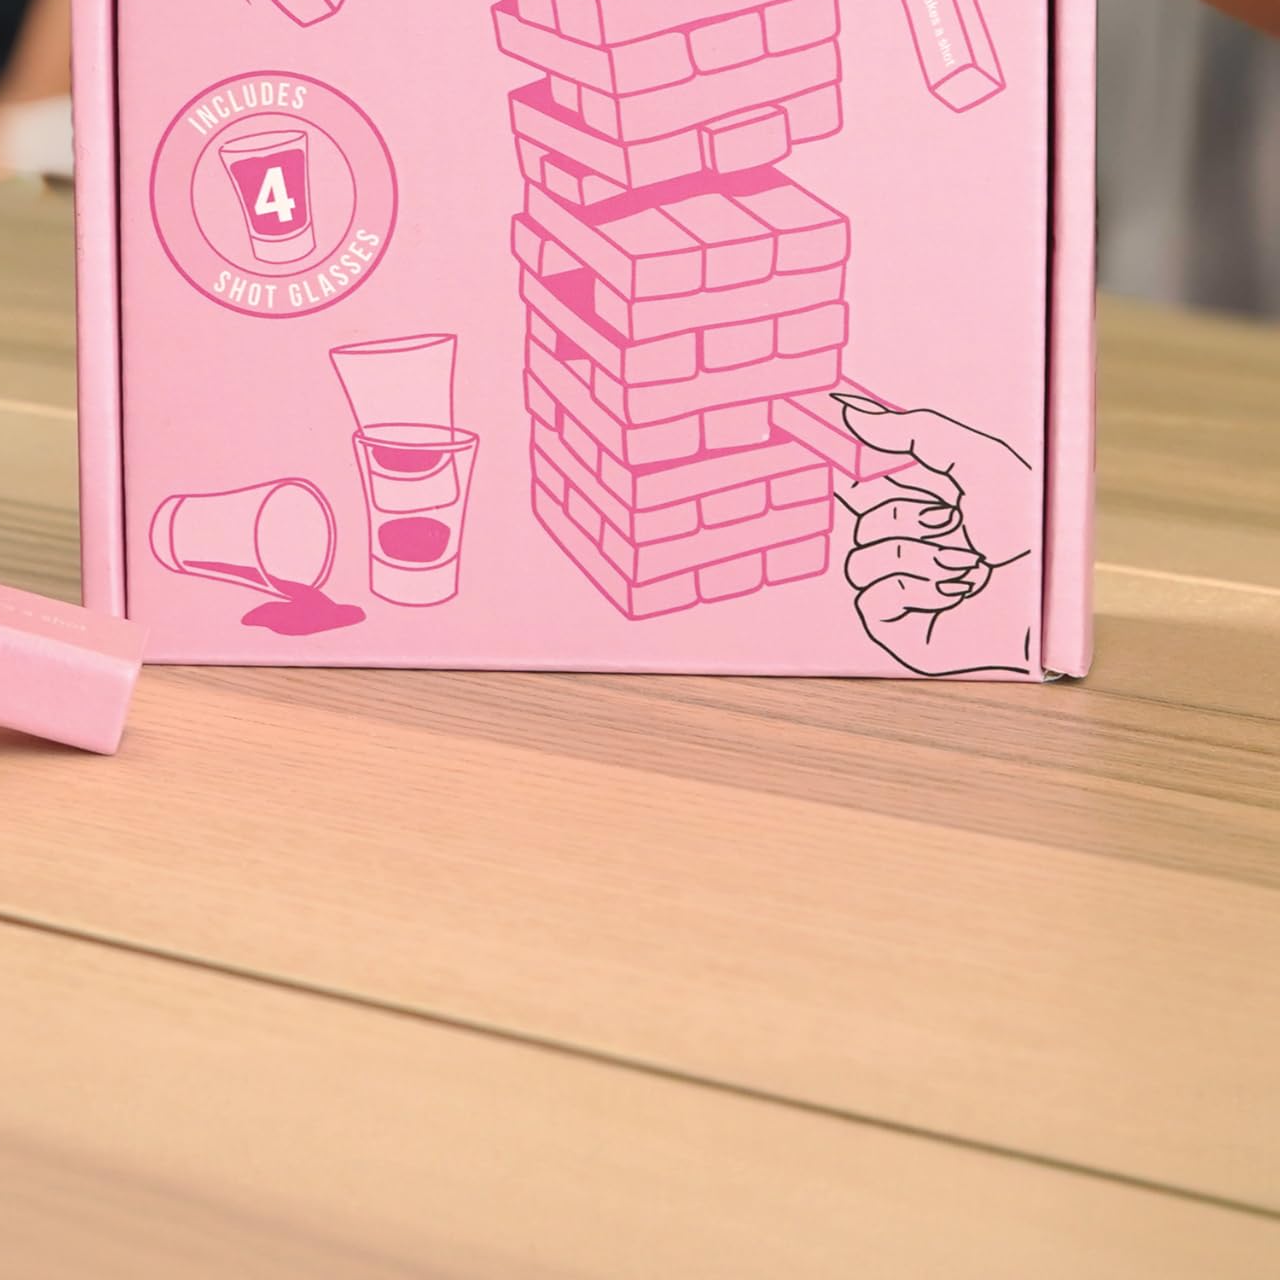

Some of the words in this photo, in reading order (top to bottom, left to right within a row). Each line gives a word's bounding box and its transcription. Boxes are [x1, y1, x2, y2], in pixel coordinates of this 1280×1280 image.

[934, 28, 944, 37] a
[937, 38, 955, 67] shot
[187, 81, 308, 135] INCLUDES
[254, 166, 296, 223] 4
[213, 271, 277, 309] SHOT
[288, 229, 380, 308] GLASSES
